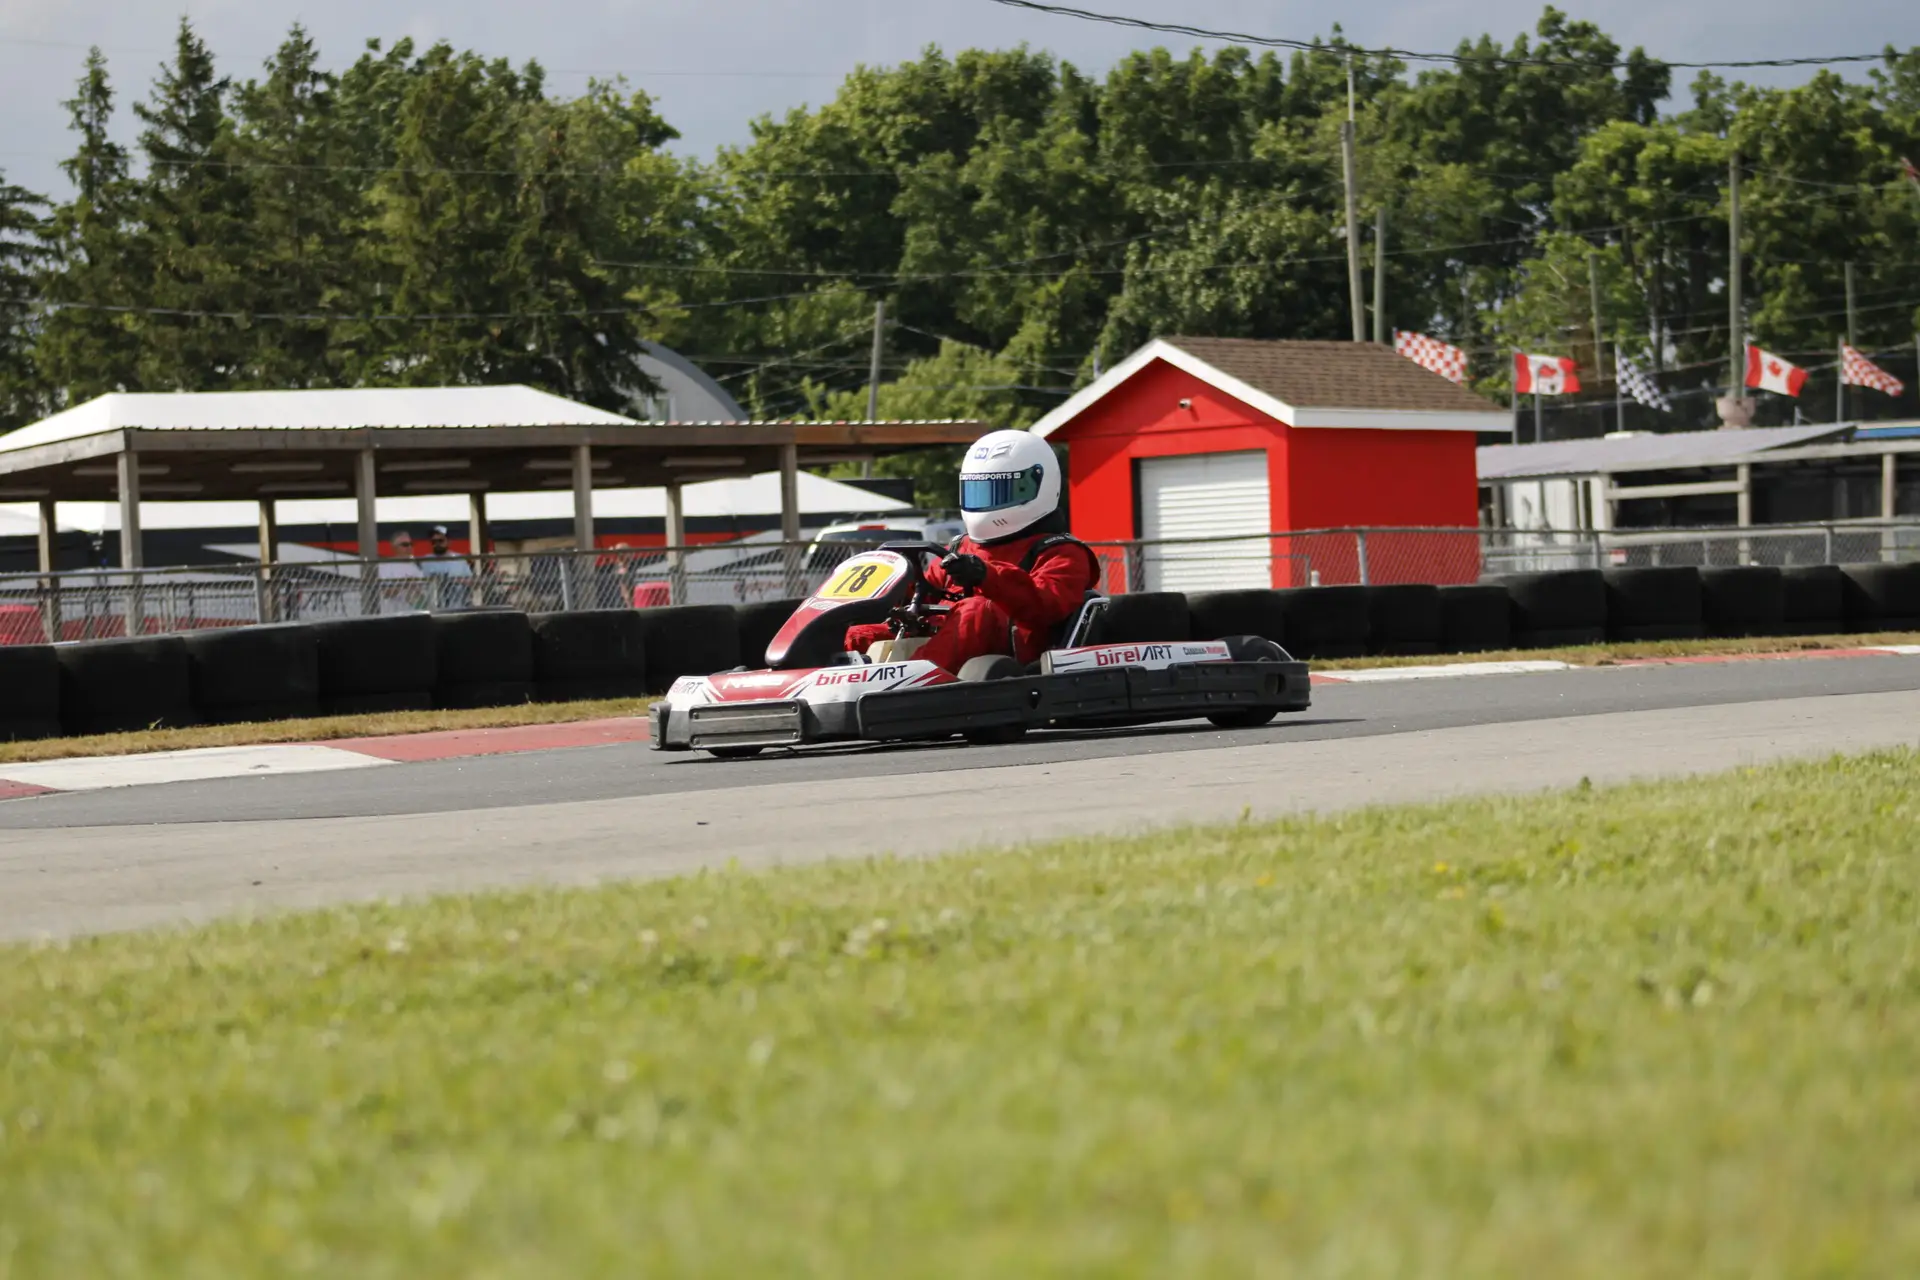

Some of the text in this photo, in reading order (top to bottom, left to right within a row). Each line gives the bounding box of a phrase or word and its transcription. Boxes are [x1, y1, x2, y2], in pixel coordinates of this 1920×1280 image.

[834, 565, 877, 593] 78
[1096, 645, 1172, 666] birelART
[816, 664, 907, 686] birelART
